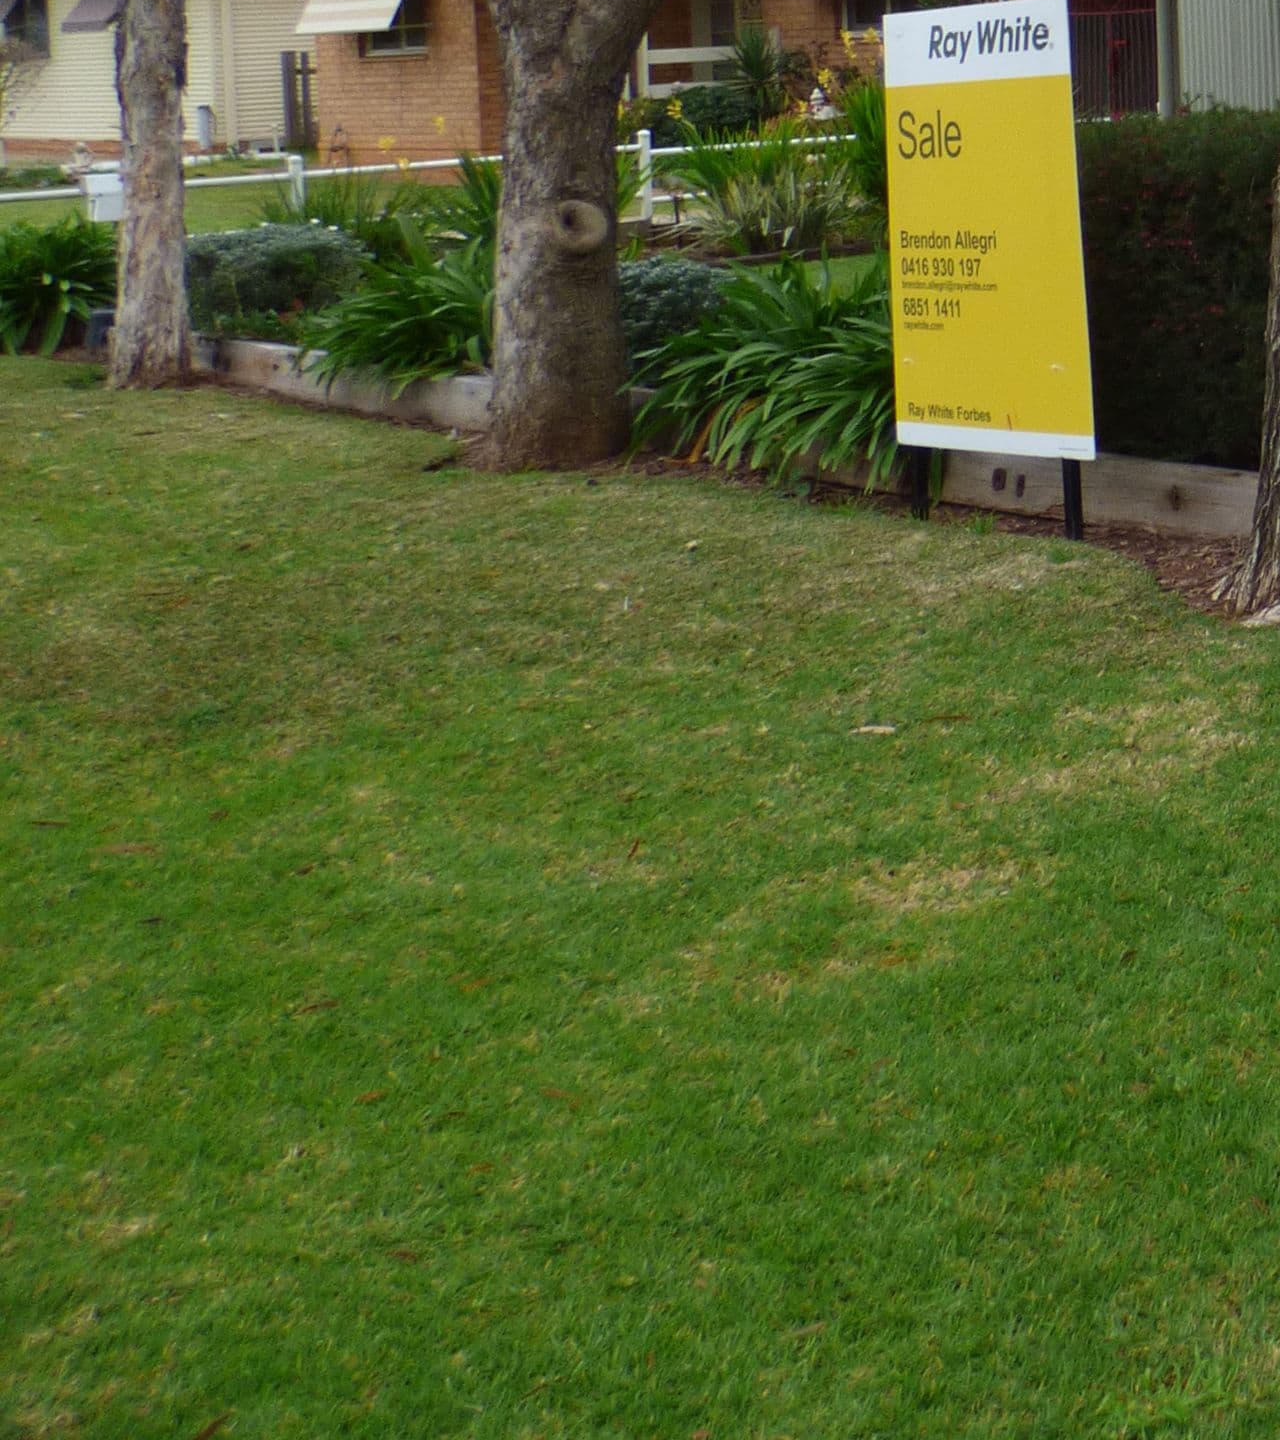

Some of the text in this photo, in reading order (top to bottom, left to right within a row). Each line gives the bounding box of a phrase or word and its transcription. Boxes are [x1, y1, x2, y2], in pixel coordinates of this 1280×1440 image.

[928, 16, 1049, 64] Ray White
[898, 109, 962, 159] Sale
[900, 230, 997, 254] Brendon Allegri
[901, 257, 982, 277] 0416 930 197
[903, 298, 961, 318] 6851 1411
[908, 402, 992, 423] Ray White Forbes
